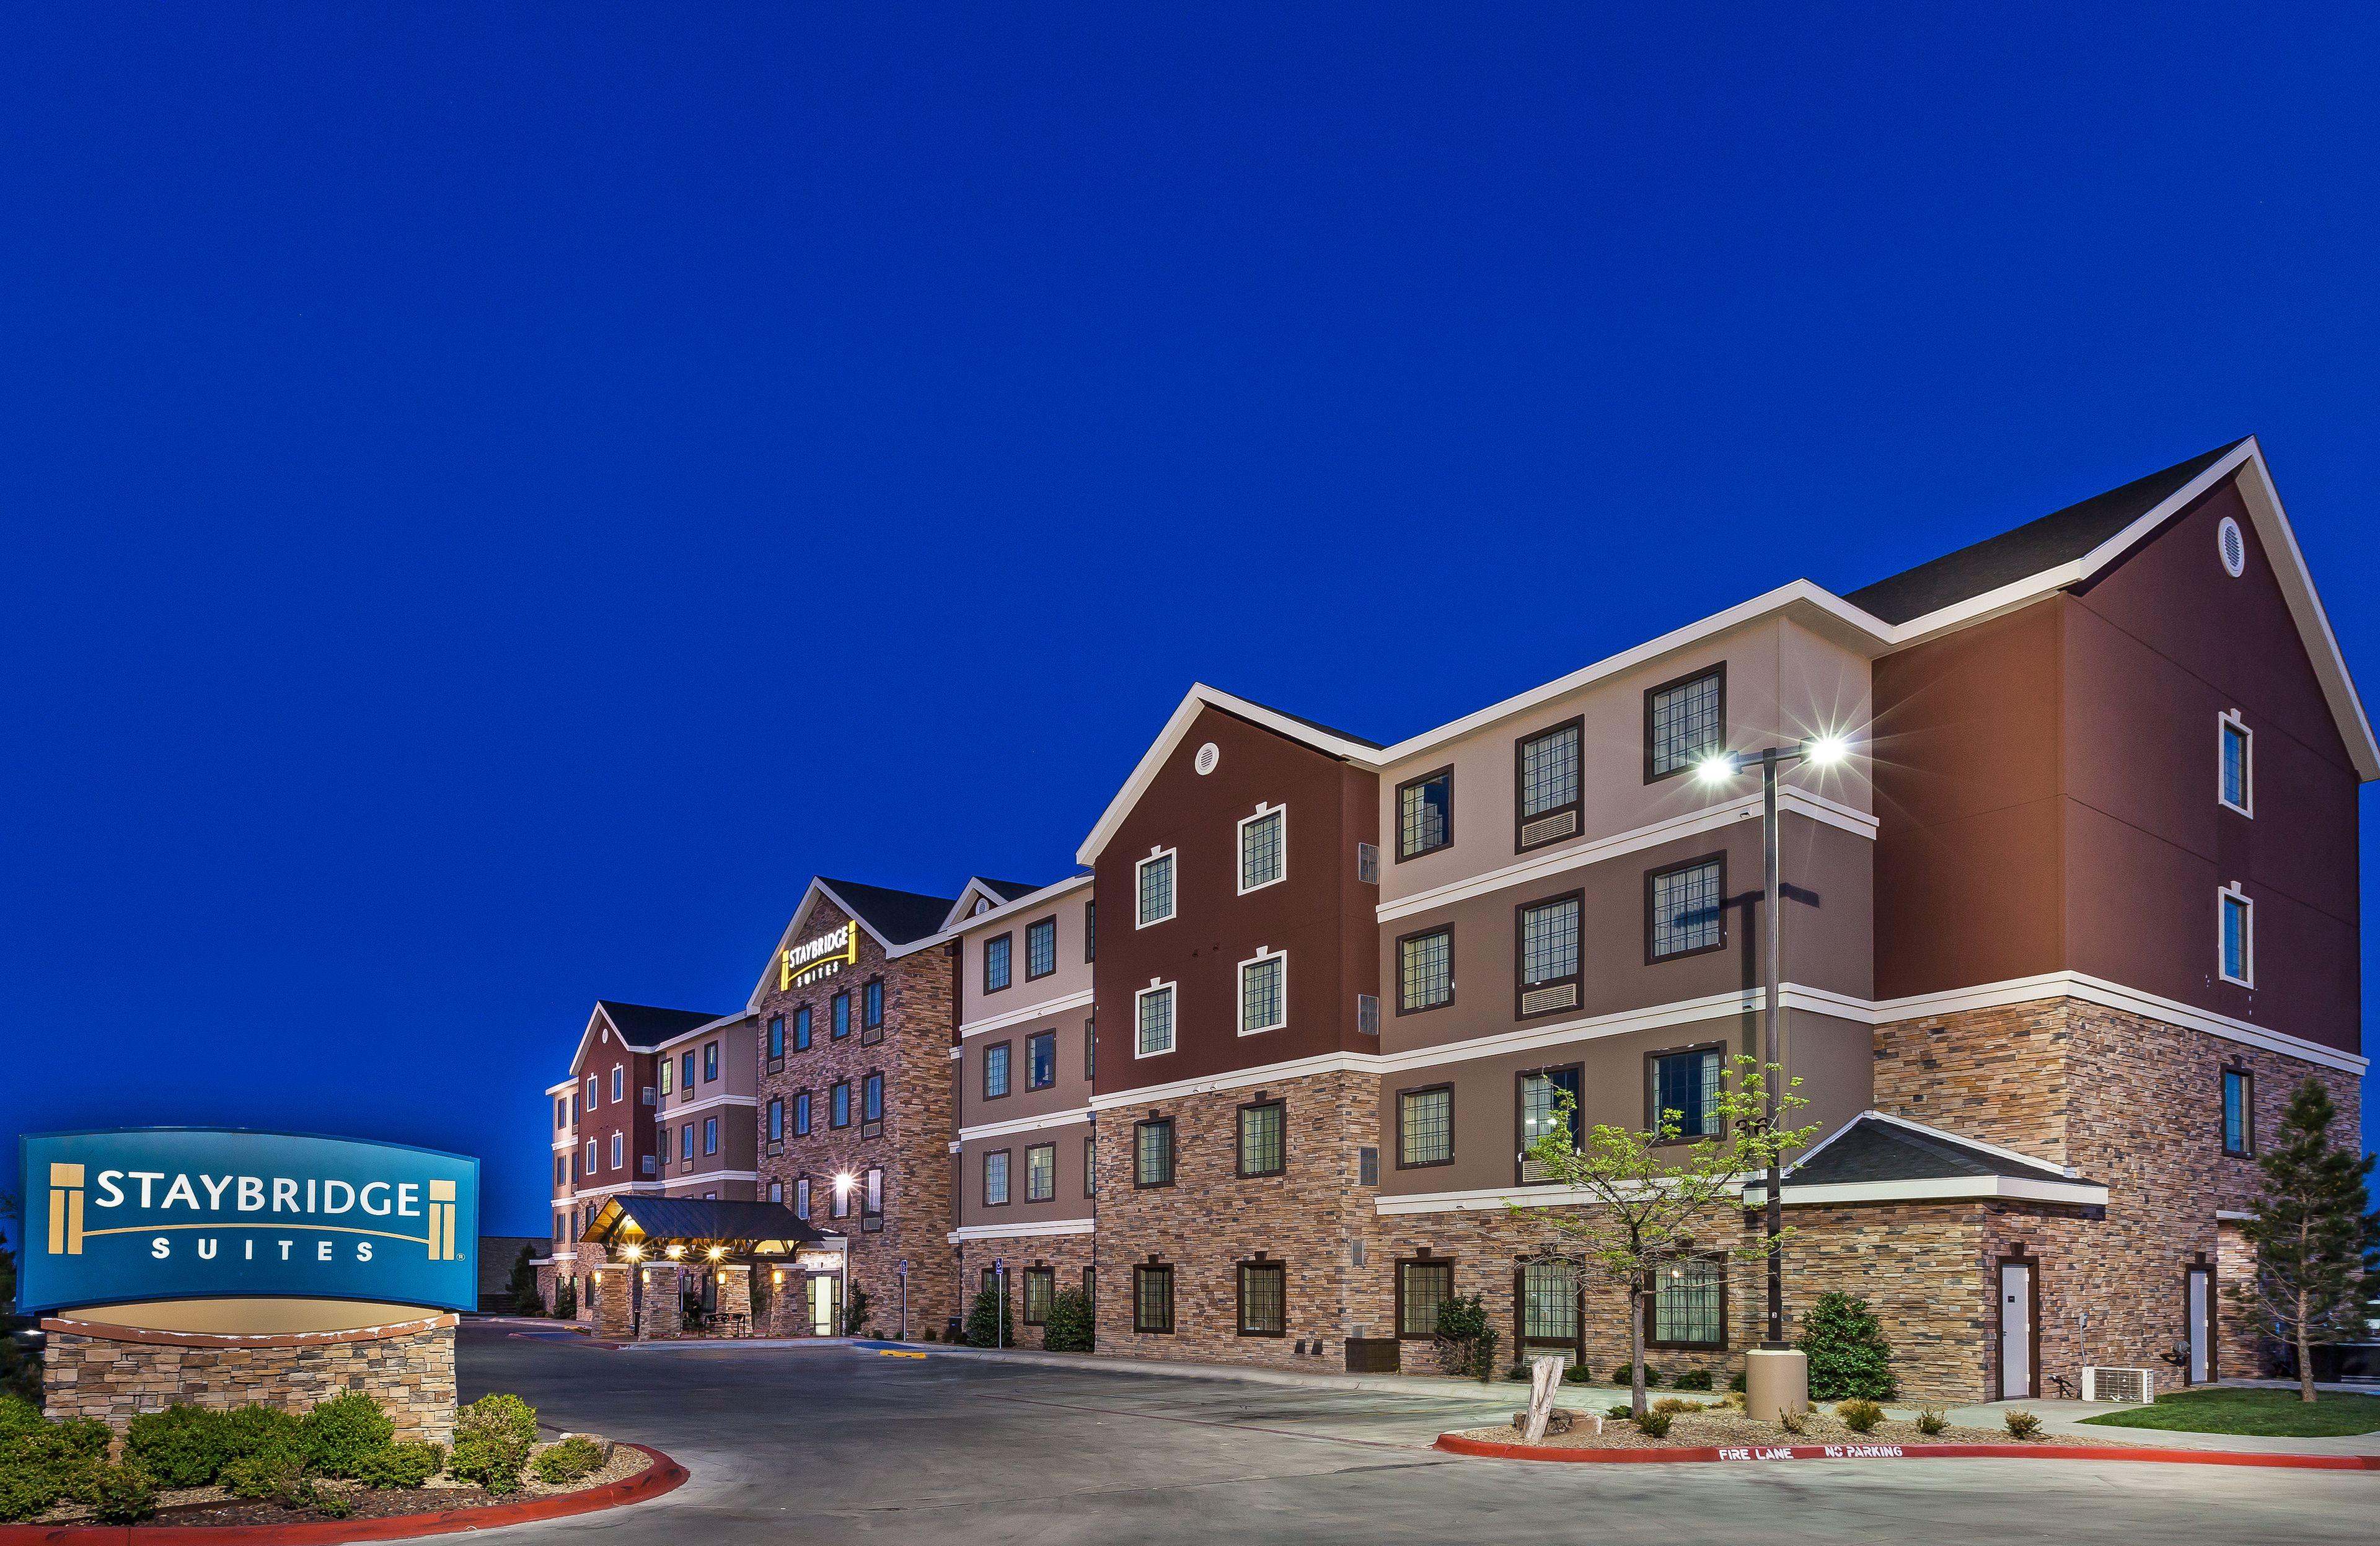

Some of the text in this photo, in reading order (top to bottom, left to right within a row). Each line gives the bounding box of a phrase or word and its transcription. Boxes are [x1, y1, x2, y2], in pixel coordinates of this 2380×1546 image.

[788, 925, 848, 968] STAYBRIDGE
[797, 960, 839, 988] SUITES
[95, 1169, 421, 1217] STAYBRIDGE
[151, 1237, 373, 1262] SUITES
[1719, 1446, 1903, 1460] FIRE LANE NO PARKING
